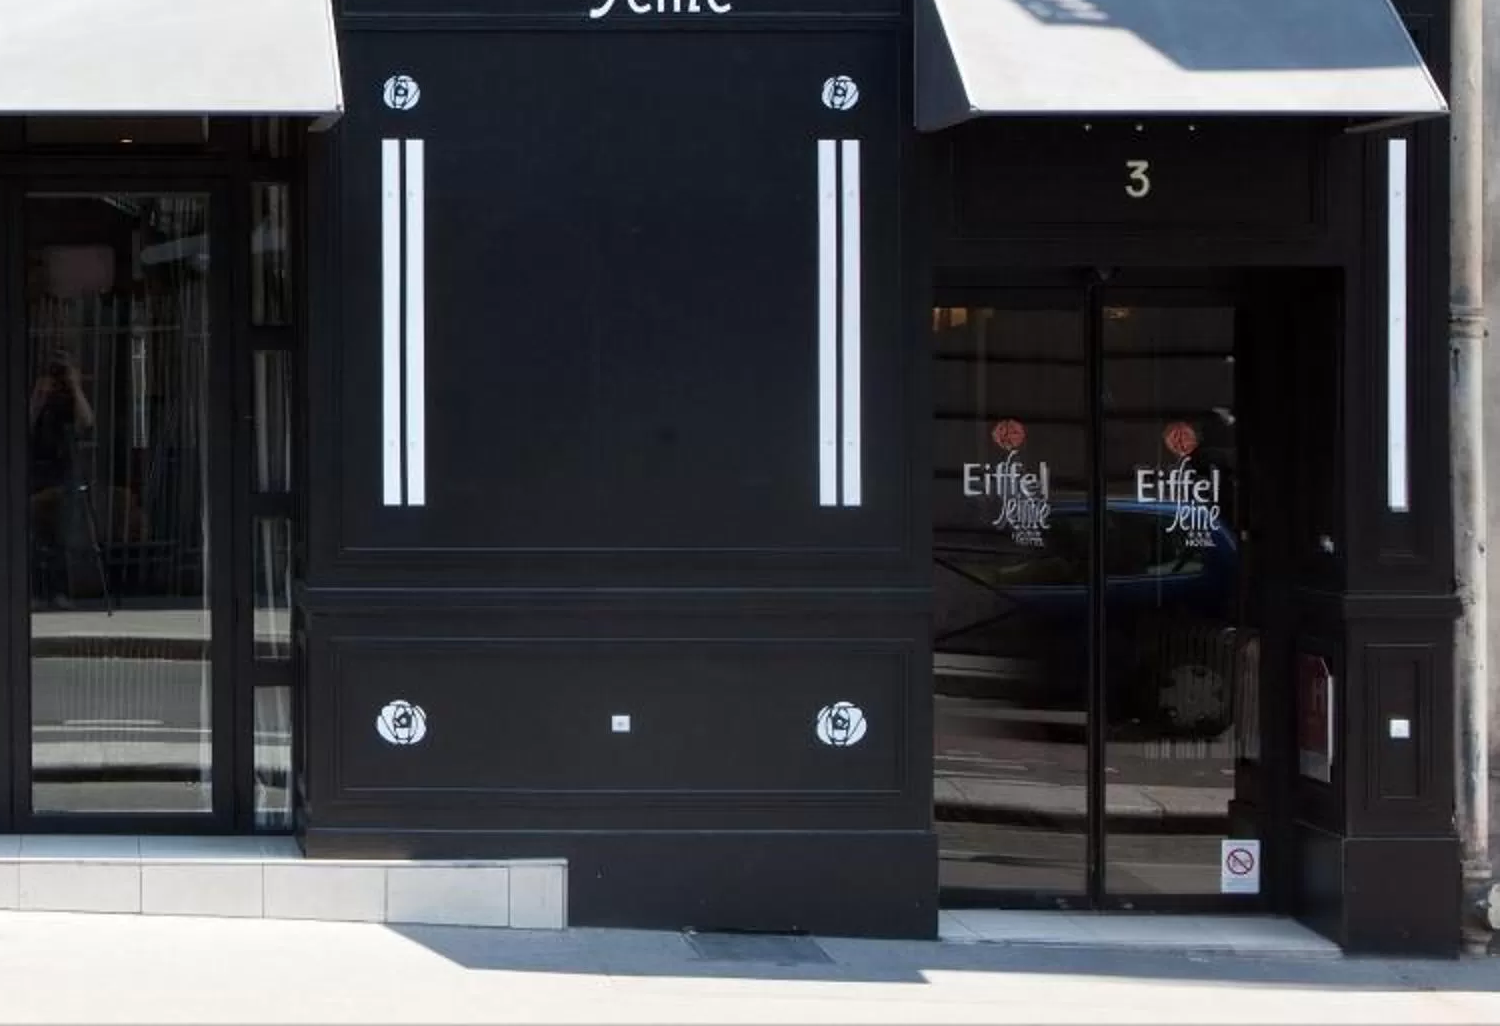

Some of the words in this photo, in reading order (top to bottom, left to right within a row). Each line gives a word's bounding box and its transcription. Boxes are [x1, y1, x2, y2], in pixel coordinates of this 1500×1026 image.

[1125, 160, 1151, 198] 3
[963, 461, 1049, 496] Eiffel
[1137, 469, 1220, 503] Eiffel
